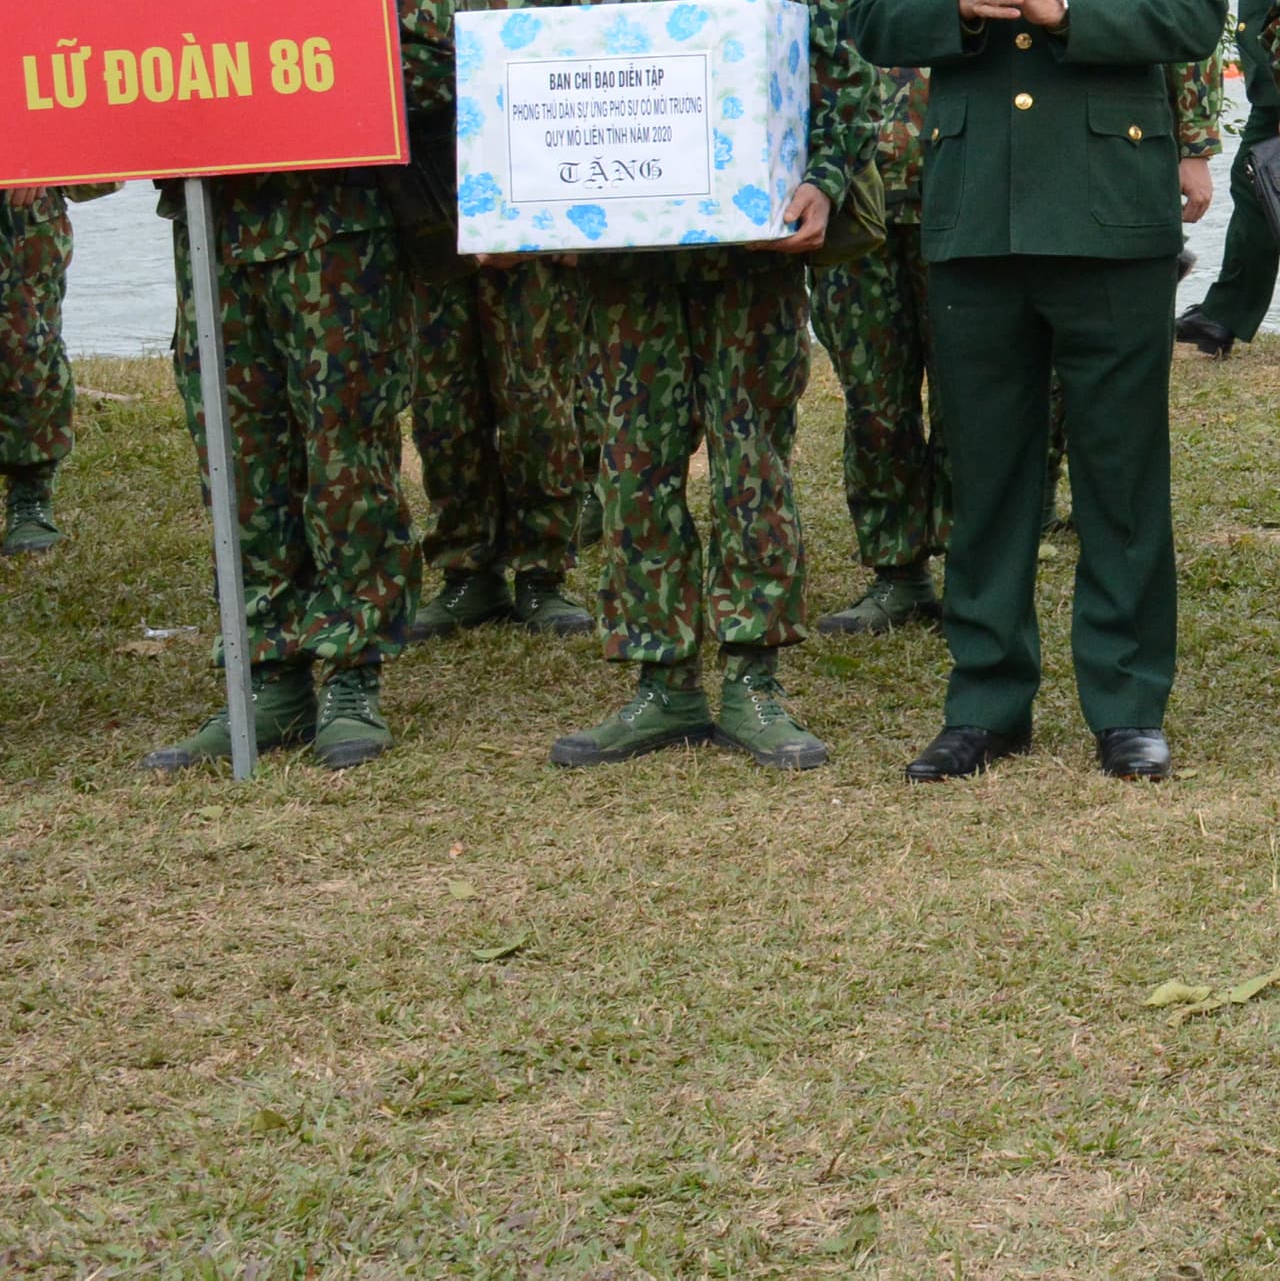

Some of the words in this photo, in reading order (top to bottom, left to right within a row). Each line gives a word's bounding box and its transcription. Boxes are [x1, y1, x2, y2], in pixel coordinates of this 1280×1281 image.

[22, 38, 92, 111] LỮ
[103, 32, 253, 105] ĐOÀN
[268, 36, 335, 95] 86
[549, 72, 571, 90] BAN
[574, 65, 592, 89] CHỈ
[594, 70, 615, 93] ĐẠO
[618, 62, 643, 88] DIỄN
[645, 65, 665, 91] TẬP
[512, 99, 540, 121] PHÒNG
[542, 98, 557, 119] THỦ
[558, 98, 576, 119] DÂN
[577, 100, 590, 122] SỰ
[627, 98, 639, 120] SỰ
[653, 94, 667, 115] MÔI
[669, 93, 702, 115] TRƯỜNG
[545, 129, 566, 148] QUY
[567, 125, 582, 146] MÔ
[583, 124, 605, 146] LIÊN
[630, 122, 651, 144] NĂM
[652, 125, 672, 143] 2020
[557, 156, 663, 190] TẶNG
